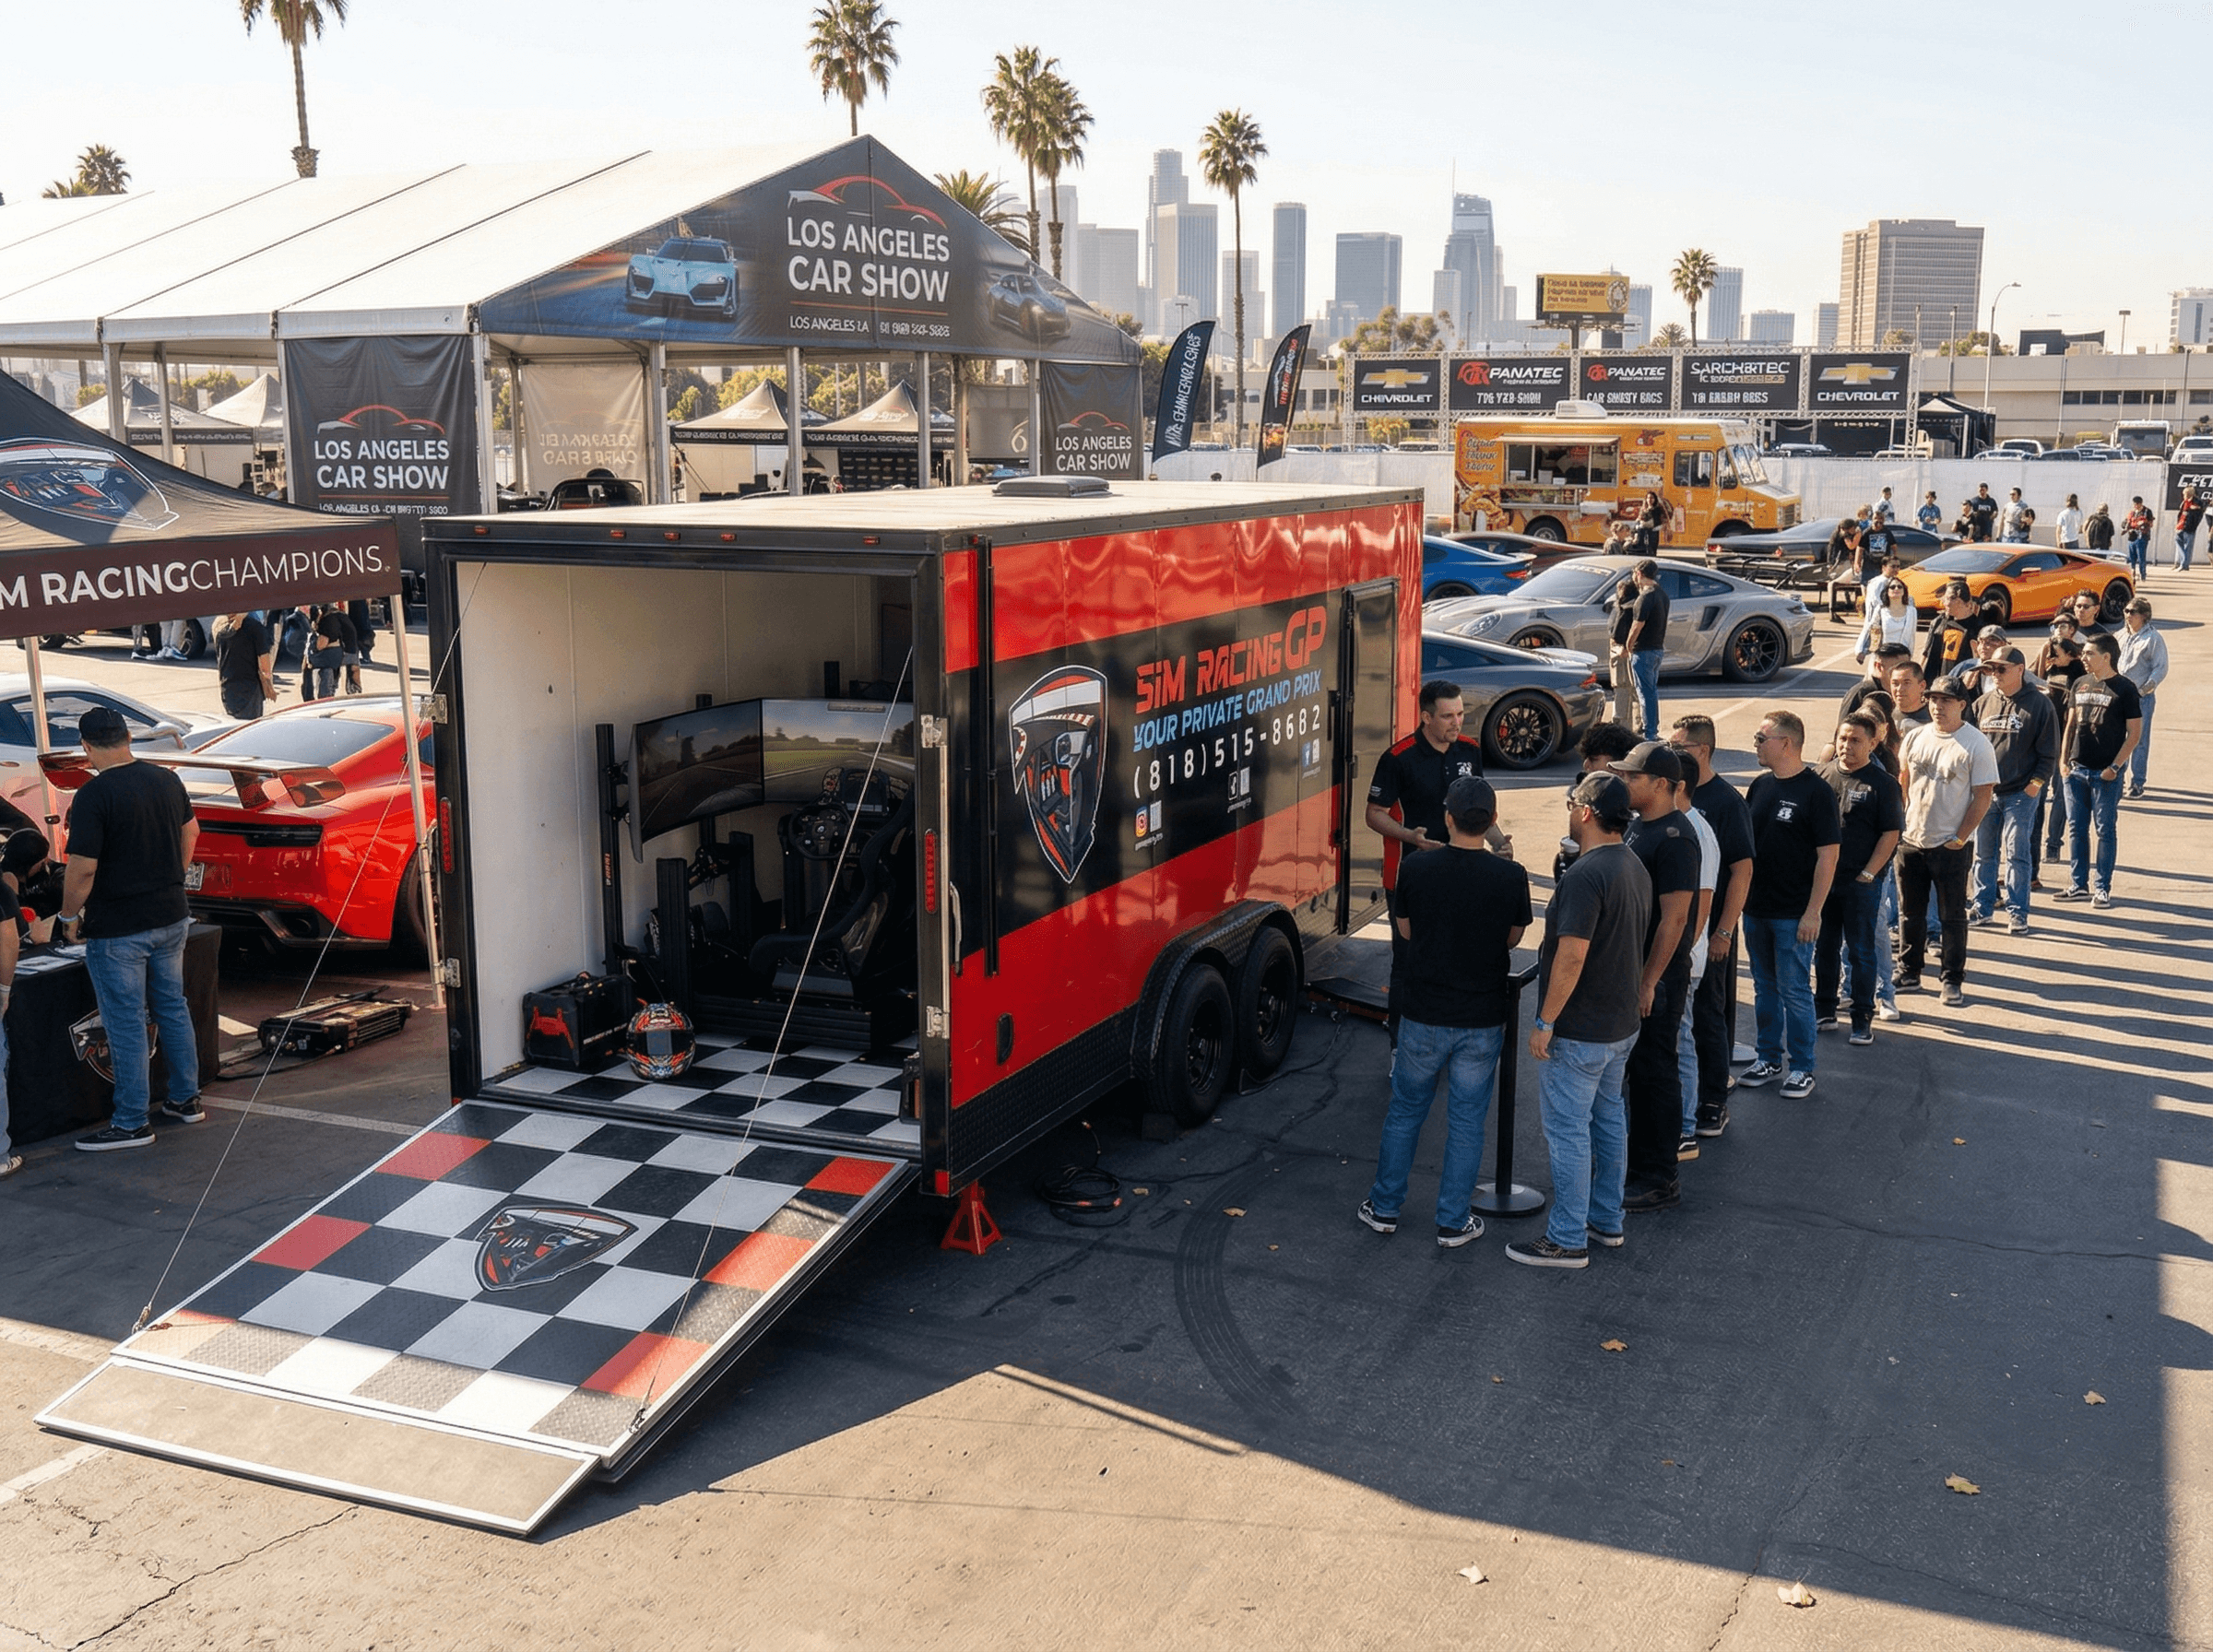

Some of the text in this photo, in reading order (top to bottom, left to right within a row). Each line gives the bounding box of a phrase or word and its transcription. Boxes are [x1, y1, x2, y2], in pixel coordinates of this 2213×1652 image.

[787, 217, 951, 263] LOS ANGELES
[788, 255, 950, 302] CAR SHOW
[789, 315, 811, 330] LOS
[811, 317, 856, 332] ANGELES
[1817, 391, 1899, 402] CHEVROLET
[314, 439, 450, 460] LOS ANGELES
[1055, 435, 1132, 451] LOS ANGELES
[1056, 453, 1131, 471] CAR SHOW
[316, 465, 449, 490] CAR SHOW
[1133, 668, 1322, 752] YOUR PRIVATE GRAND PRIX
